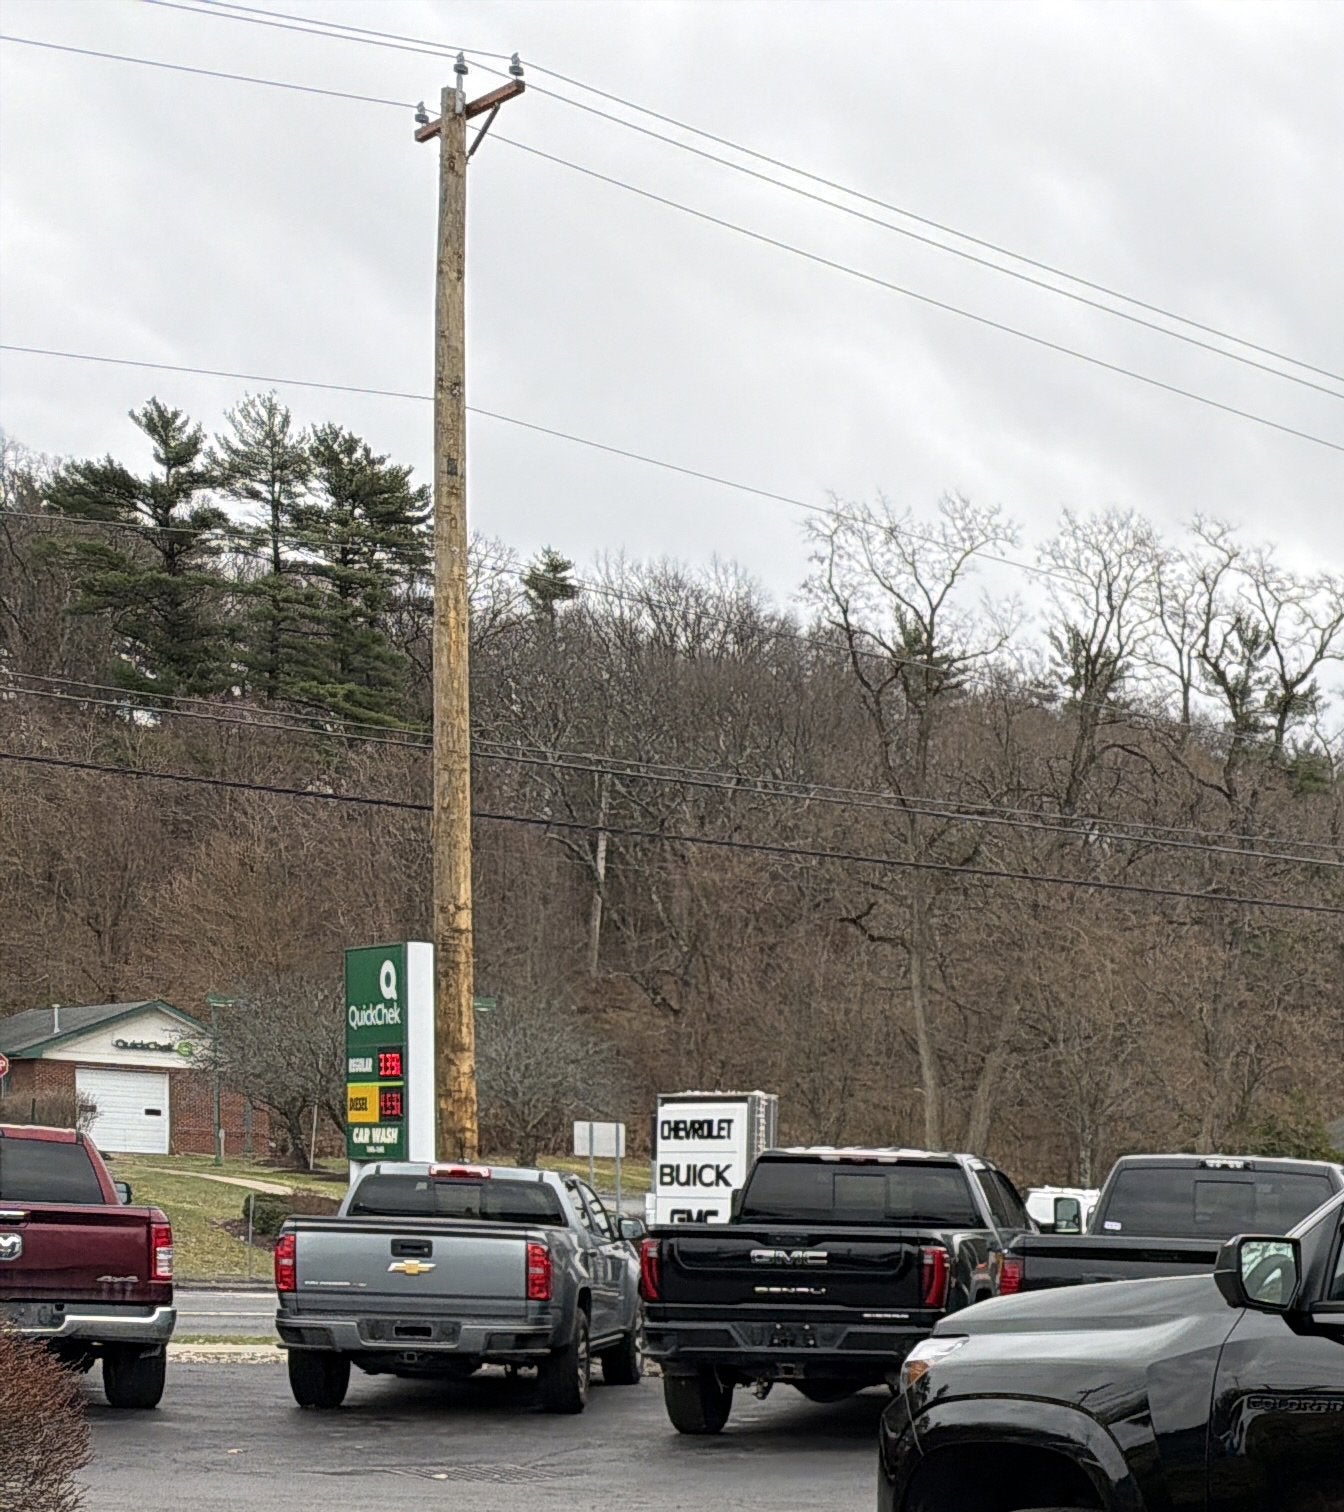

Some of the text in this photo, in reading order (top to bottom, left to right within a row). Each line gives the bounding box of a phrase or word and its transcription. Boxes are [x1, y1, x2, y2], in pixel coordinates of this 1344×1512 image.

[380, 960, 397, 1000] Q
[348, 1002, 401, 1030] QuickChek
[353, 1127, 399, 1144] CAR WASH
[660, 1118, 734, 1140] CHEVROLET
[660, 1164, 733, 1187] BUICK
[750, 1250, 828, 1265] GMC
